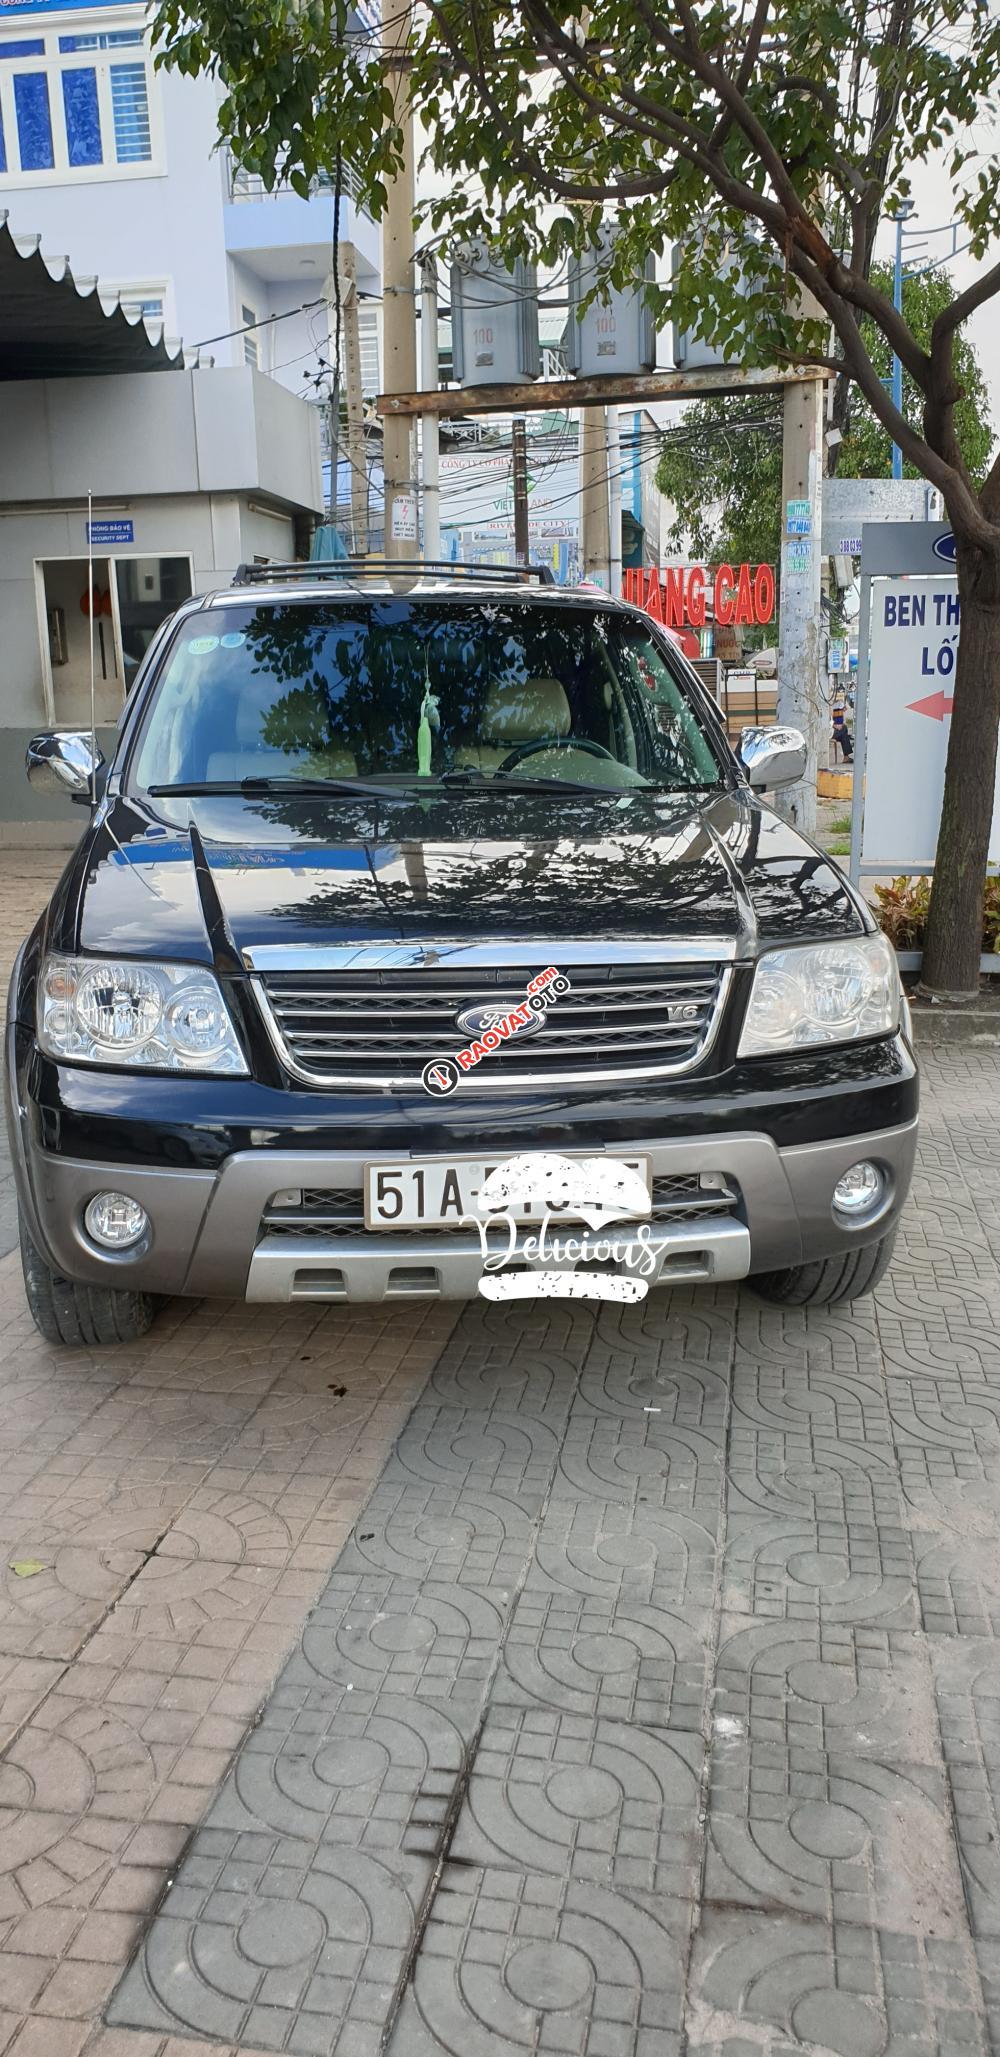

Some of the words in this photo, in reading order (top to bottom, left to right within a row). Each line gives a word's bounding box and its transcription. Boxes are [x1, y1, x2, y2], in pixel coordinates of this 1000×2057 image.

[473, 328, 494, 344] 100
[595, 317, 616, 334] 100
[714, 563, 775, 625] CAO
[884, 595, 926, 627] BEN
[933, 595, 961, 626] TH
[922, 635, 959, 676] LỐ
[666, 1005, 700, 1022] V6
